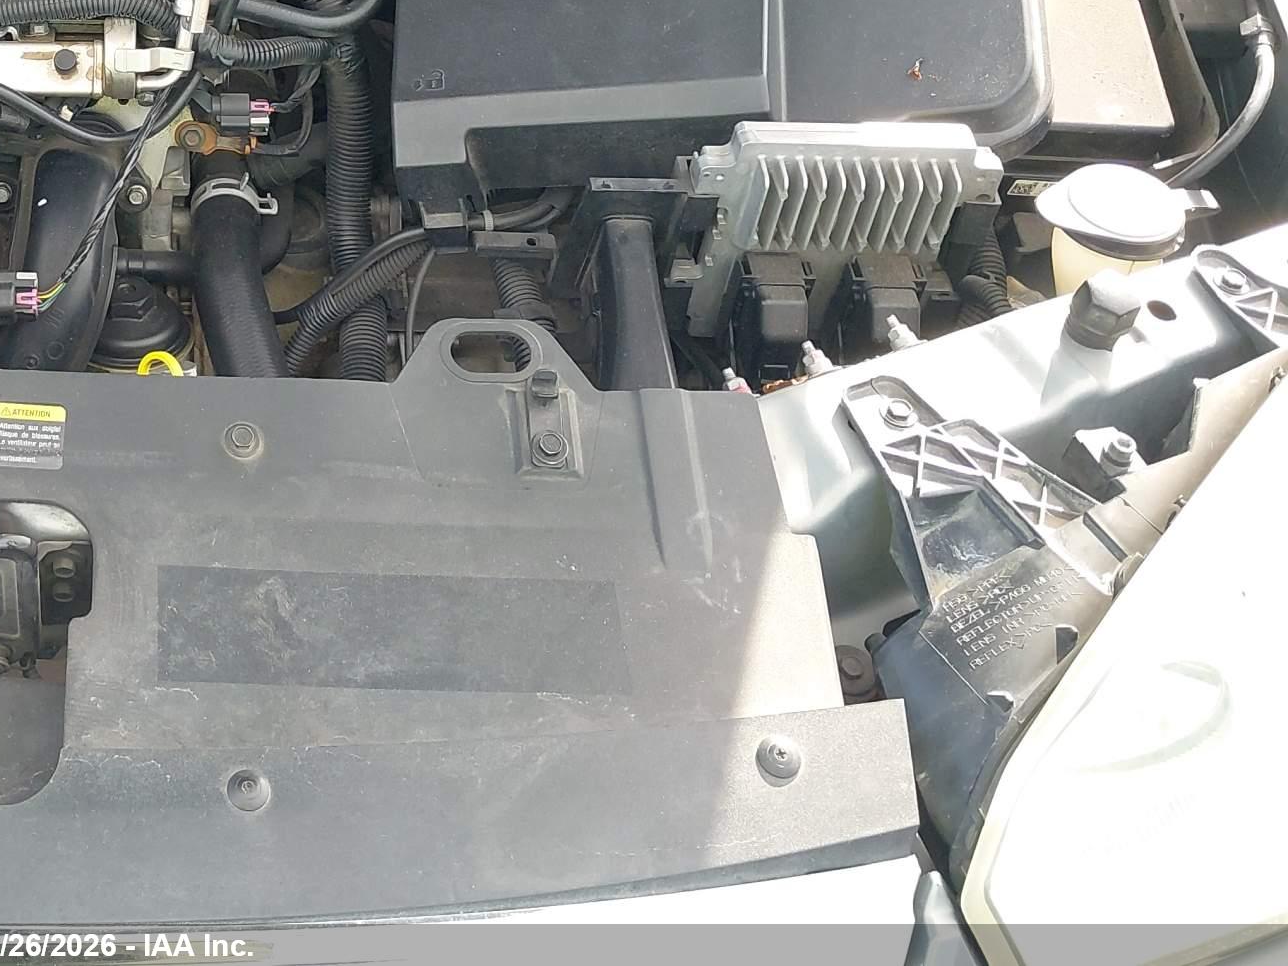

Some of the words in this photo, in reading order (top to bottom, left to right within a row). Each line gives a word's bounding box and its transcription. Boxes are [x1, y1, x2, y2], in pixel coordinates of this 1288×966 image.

[12, 409, 51, 418] ATTENTION
[946, 601, 979, 623] LENS
[964, 634, 996, 656] LENS
